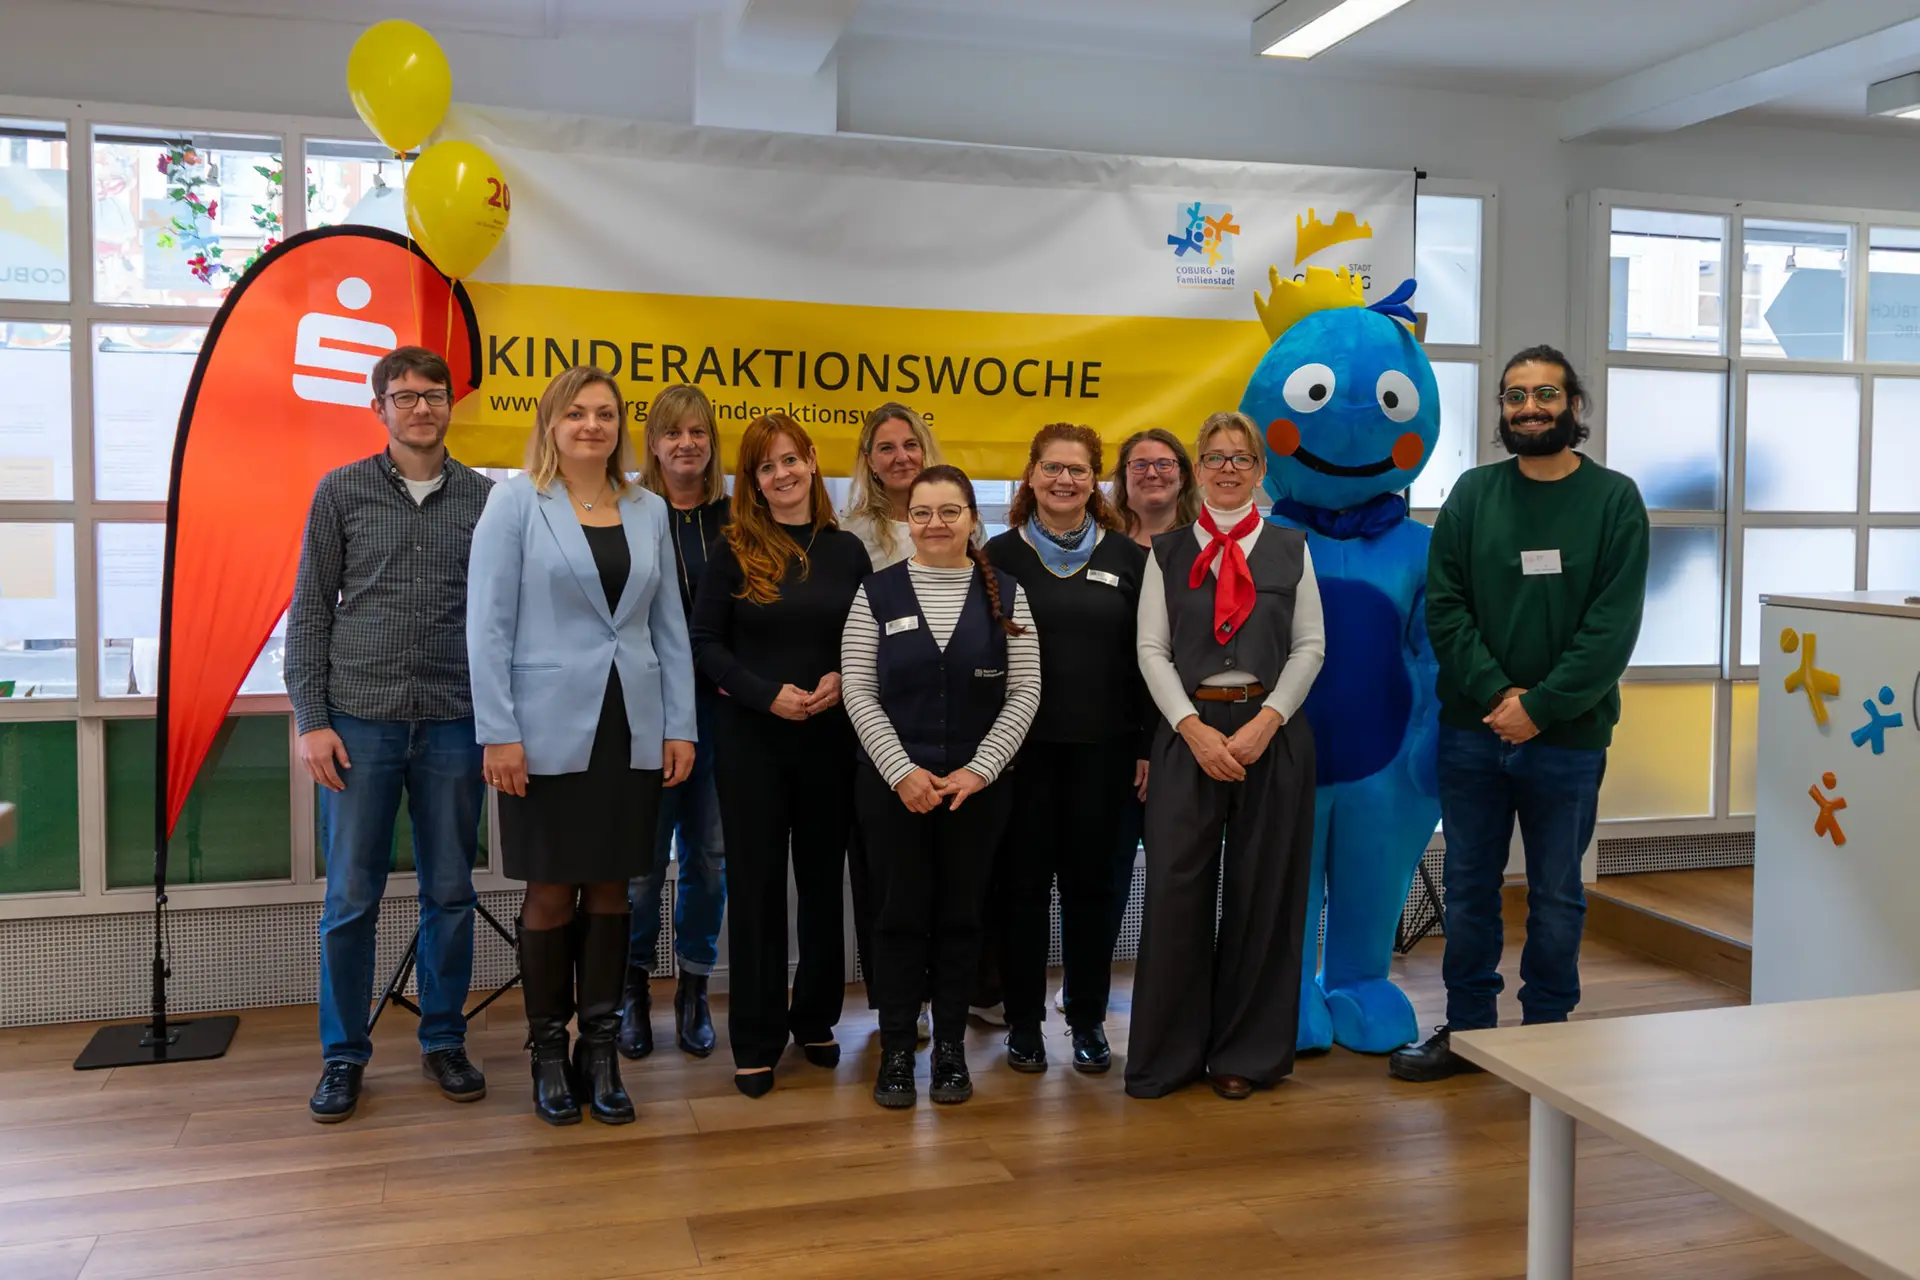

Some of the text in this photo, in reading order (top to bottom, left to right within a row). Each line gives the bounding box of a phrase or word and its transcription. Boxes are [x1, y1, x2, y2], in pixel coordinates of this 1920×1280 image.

[487, 177, 511, 212] 20
[1176, 266, 1213, 275] COBURG
[1221, 266, 1235, 275] Die
[1348, 263, 1372, 272] STADT
[1176, 276, 1235, 285] Familienstadt
[489, 335, 1102, 398] KINDERAKTIONSWOCHE
